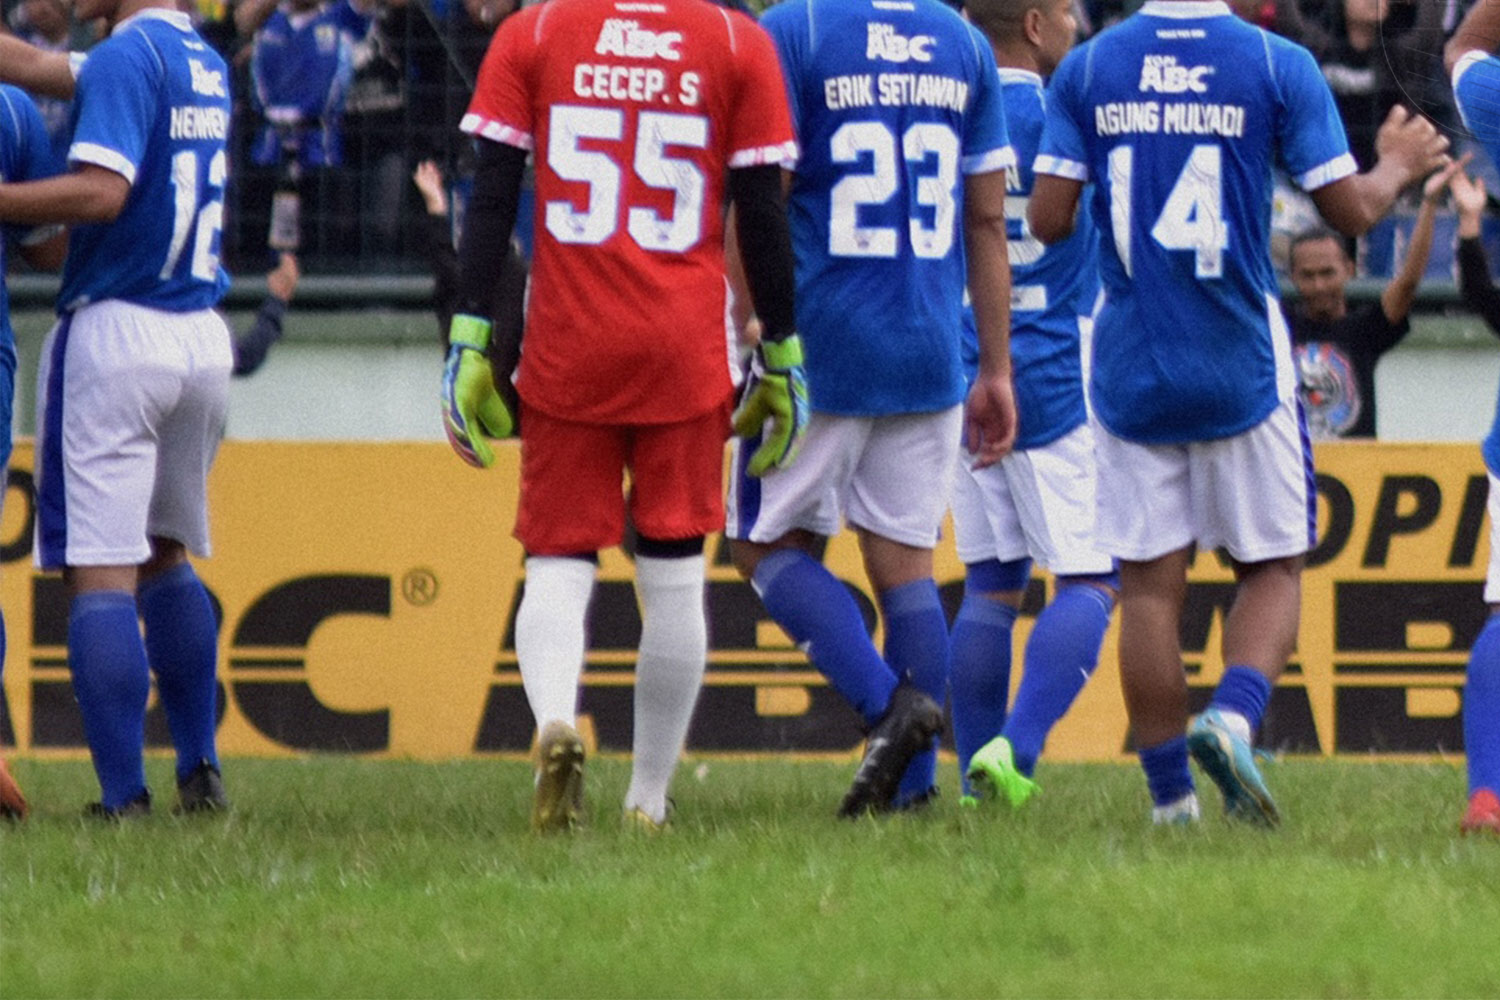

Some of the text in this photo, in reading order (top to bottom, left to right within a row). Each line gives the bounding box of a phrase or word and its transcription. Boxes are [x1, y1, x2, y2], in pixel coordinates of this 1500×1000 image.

[865, 34, 933, 64] ABC
[678, 70, 701, 107] S
[824, 72, 968, 114] ERIK SETIAWAN
[1138, 65, 1209, 94] ABC
[1095, 102, 1245, 139] AGUNG MULYADI
[545, 104, 709, 254] 55
[829, 121, 960, 260] 23
[160, 150, 228, 282] 12
[1107, 144, 1229, 281] 14
